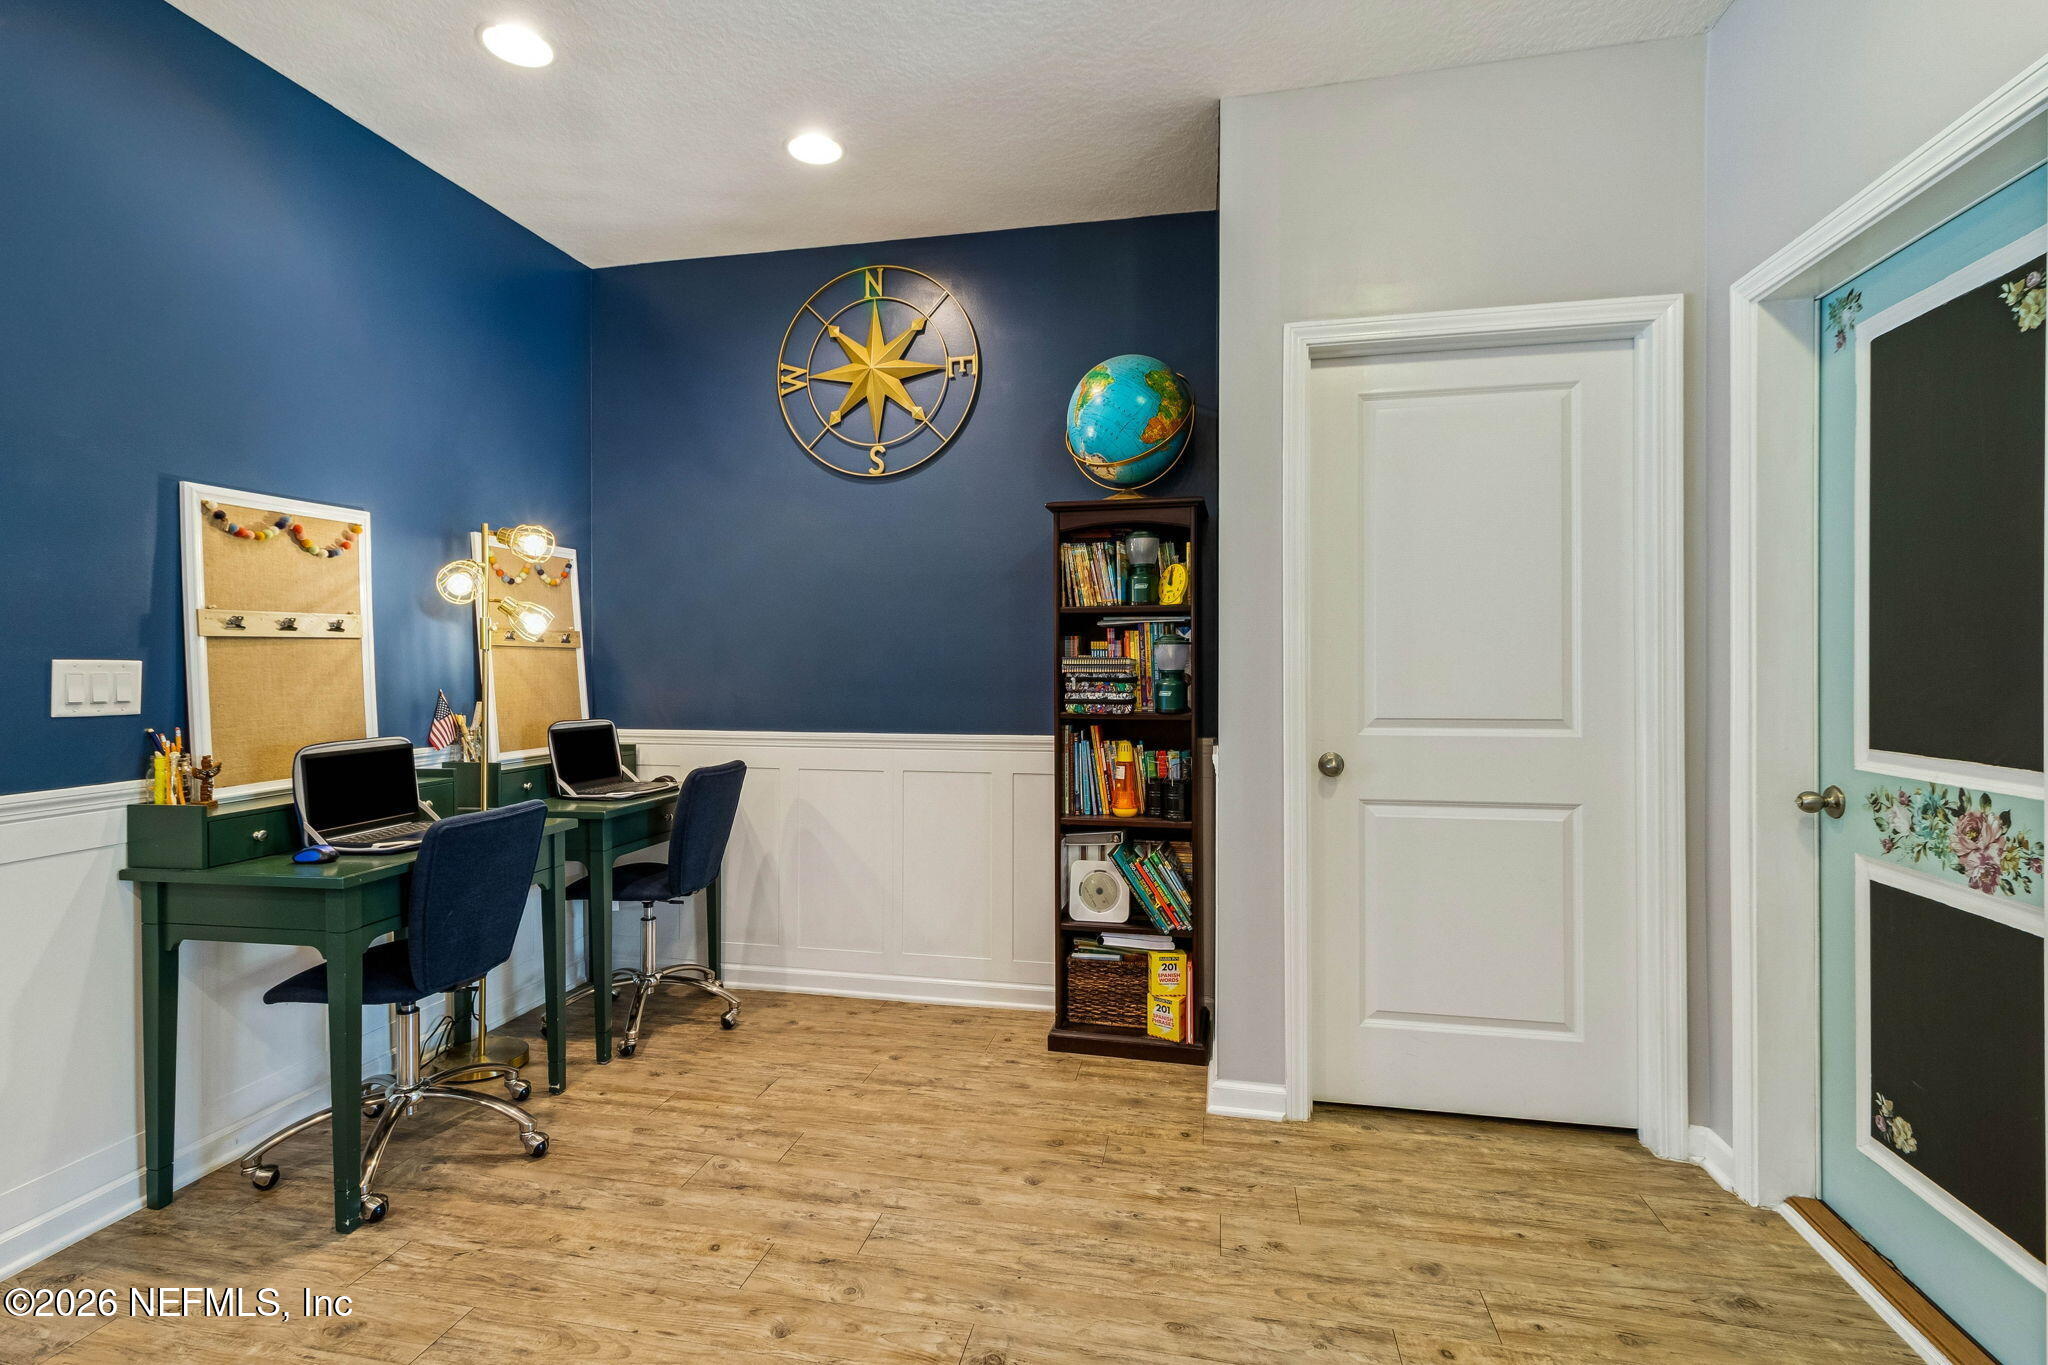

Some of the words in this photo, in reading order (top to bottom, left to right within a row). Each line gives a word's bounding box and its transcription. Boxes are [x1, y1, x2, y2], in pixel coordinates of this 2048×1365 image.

[864, 268, 884, 299] N
[948, 354, 976, 377] E
[780, 363, 808, 396] W
[868, 445, 886, 474] S
[1161, 963, 1177, 971] 201
[1156, 1004, 1170, 1014] 201
